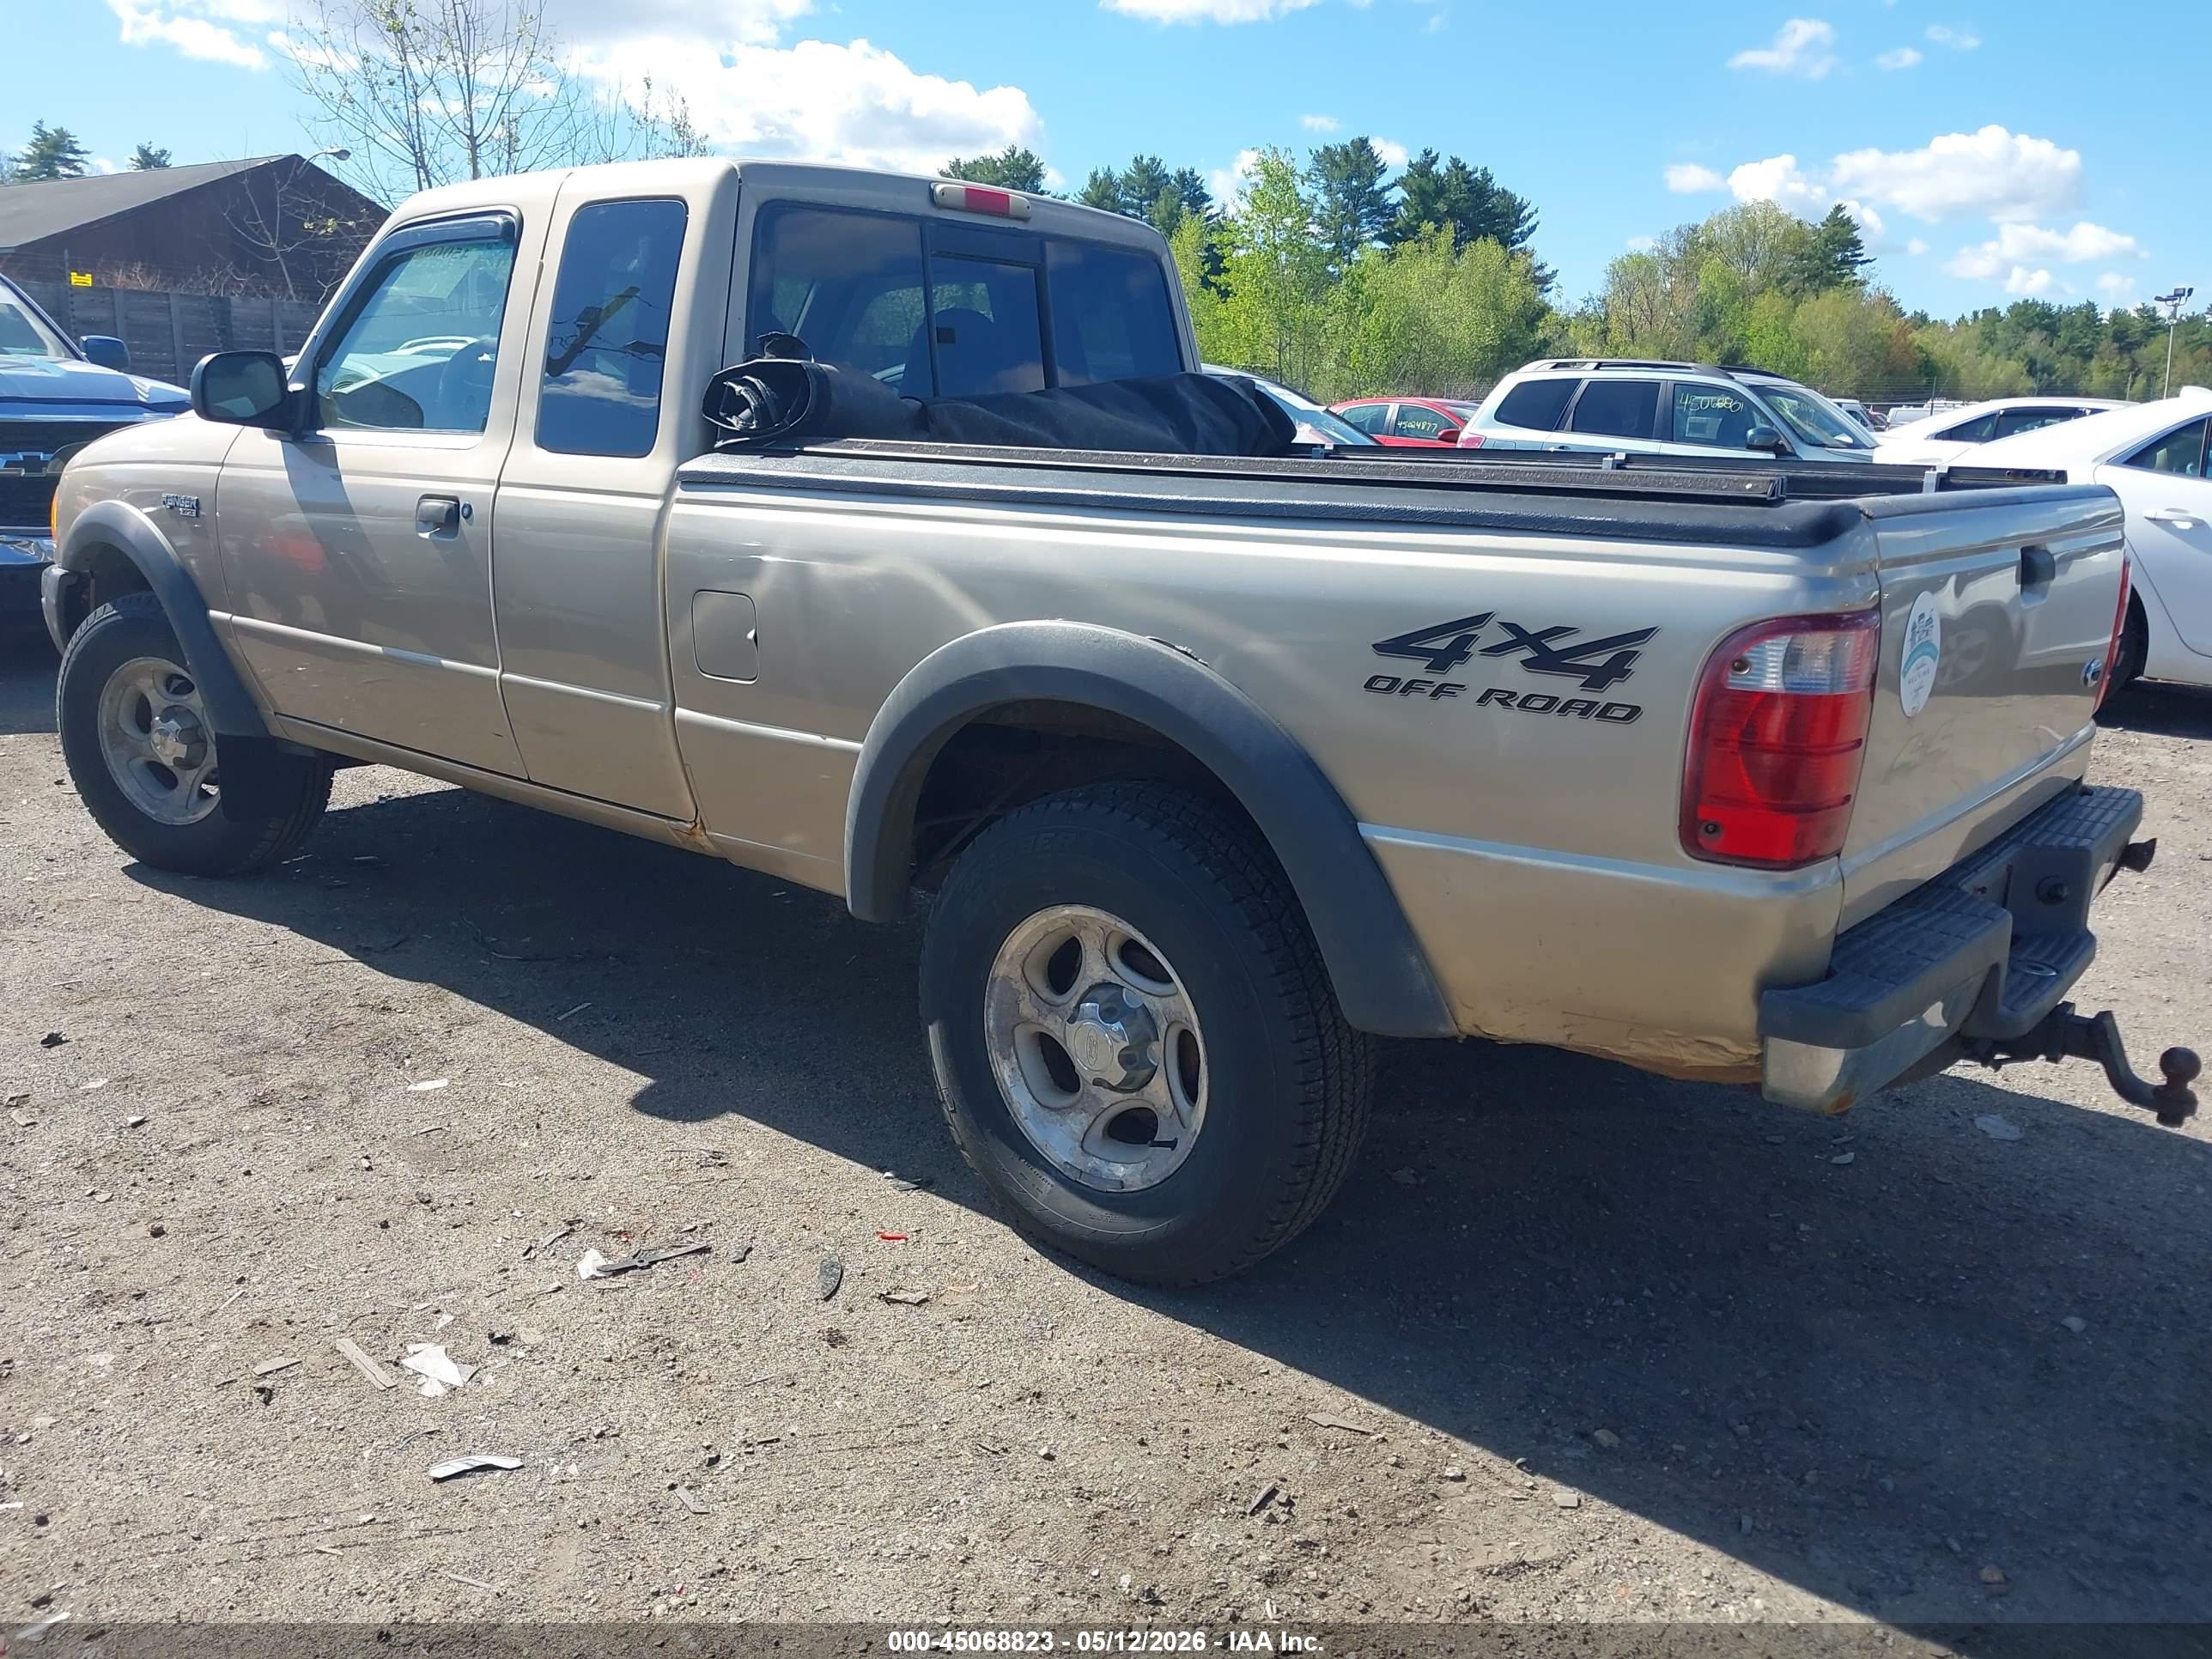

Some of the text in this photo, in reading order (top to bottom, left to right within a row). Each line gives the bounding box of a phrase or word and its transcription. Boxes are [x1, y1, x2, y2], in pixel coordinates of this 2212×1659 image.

[1397, 420, 1438, 434] 45024877
[1364, 675, 1644, 725] OFF ROAD
